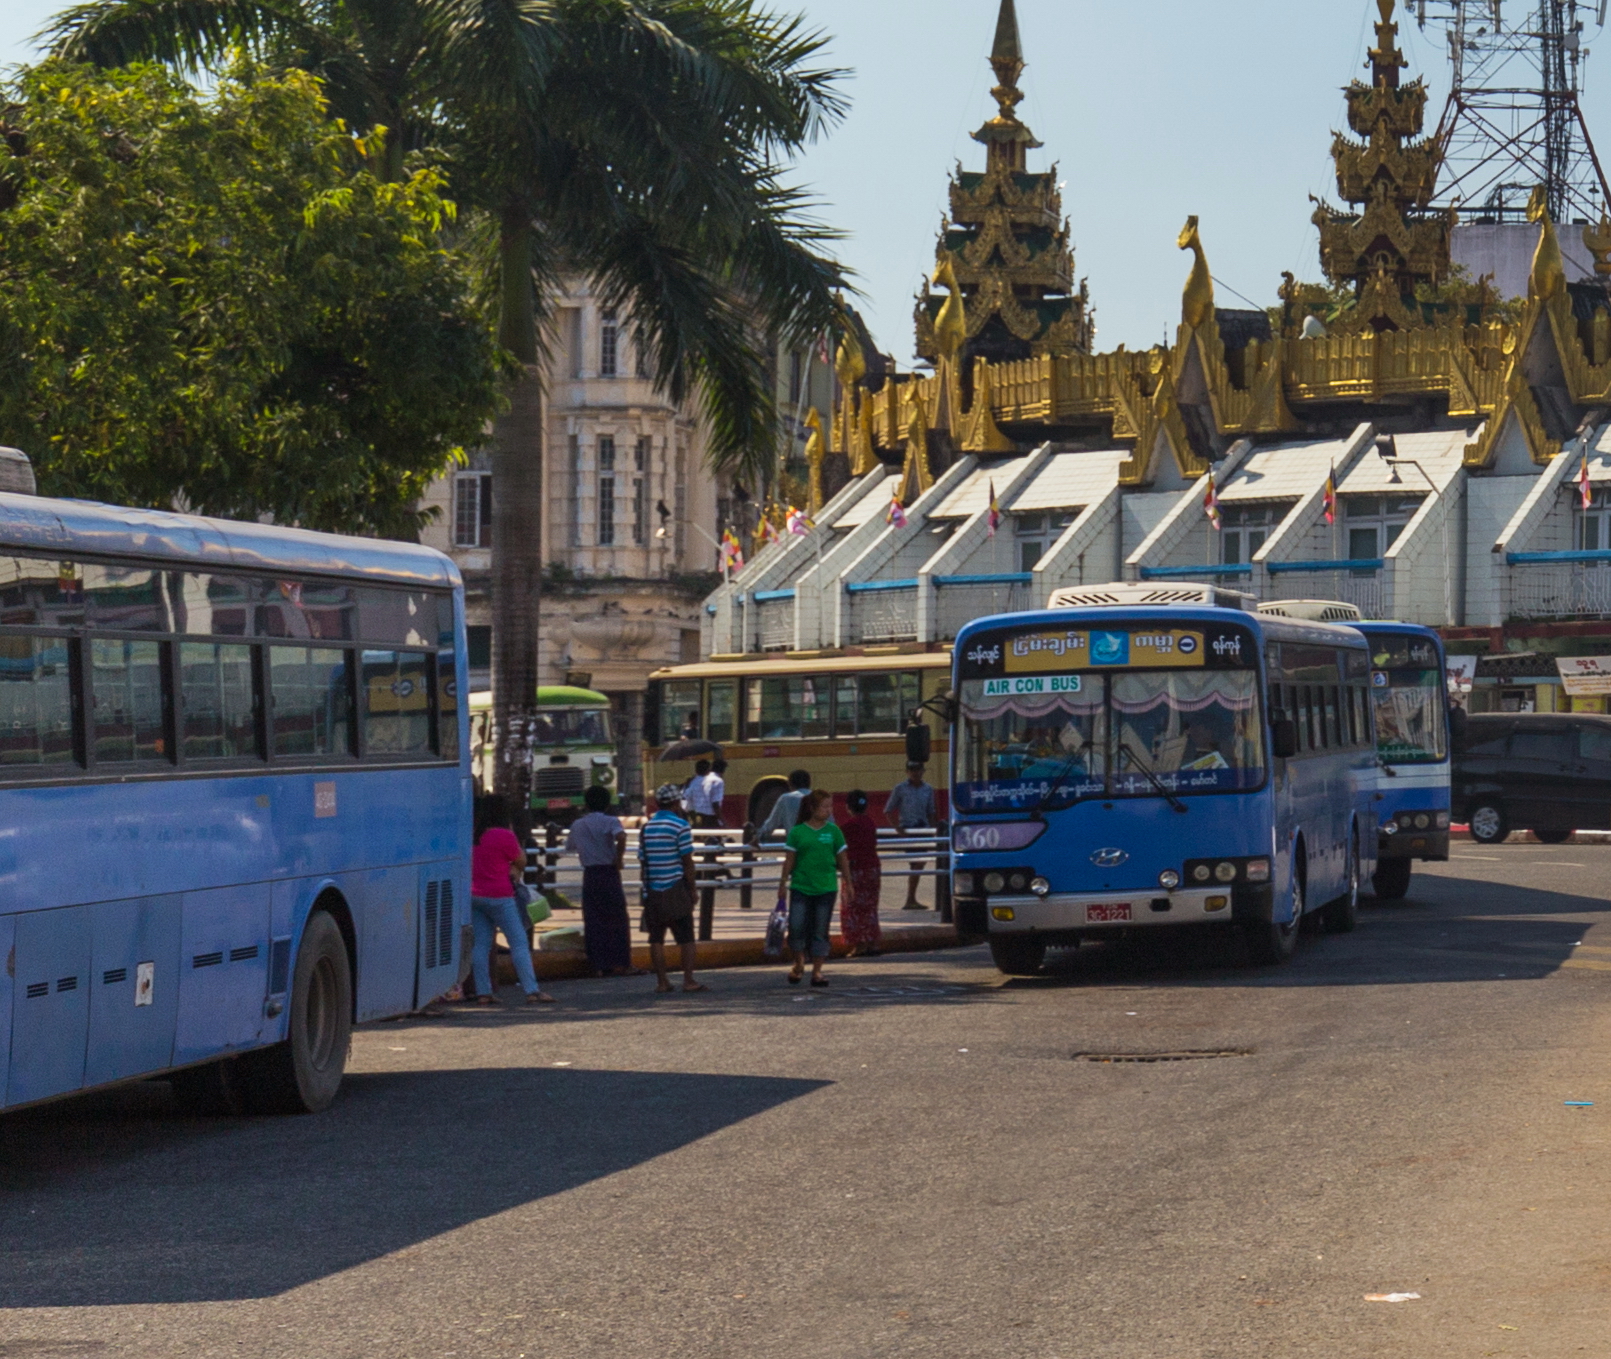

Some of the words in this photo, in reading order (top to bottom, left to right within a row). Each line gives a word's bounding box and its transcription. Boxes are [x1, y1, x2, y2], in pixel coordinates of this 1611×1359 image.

[986, 680, 1010, 694] AIR
[1015, 679, 1044, 693] CON
[1051, 676, 1079, 690] BUS
[960, 826, 1000, 849] 360
